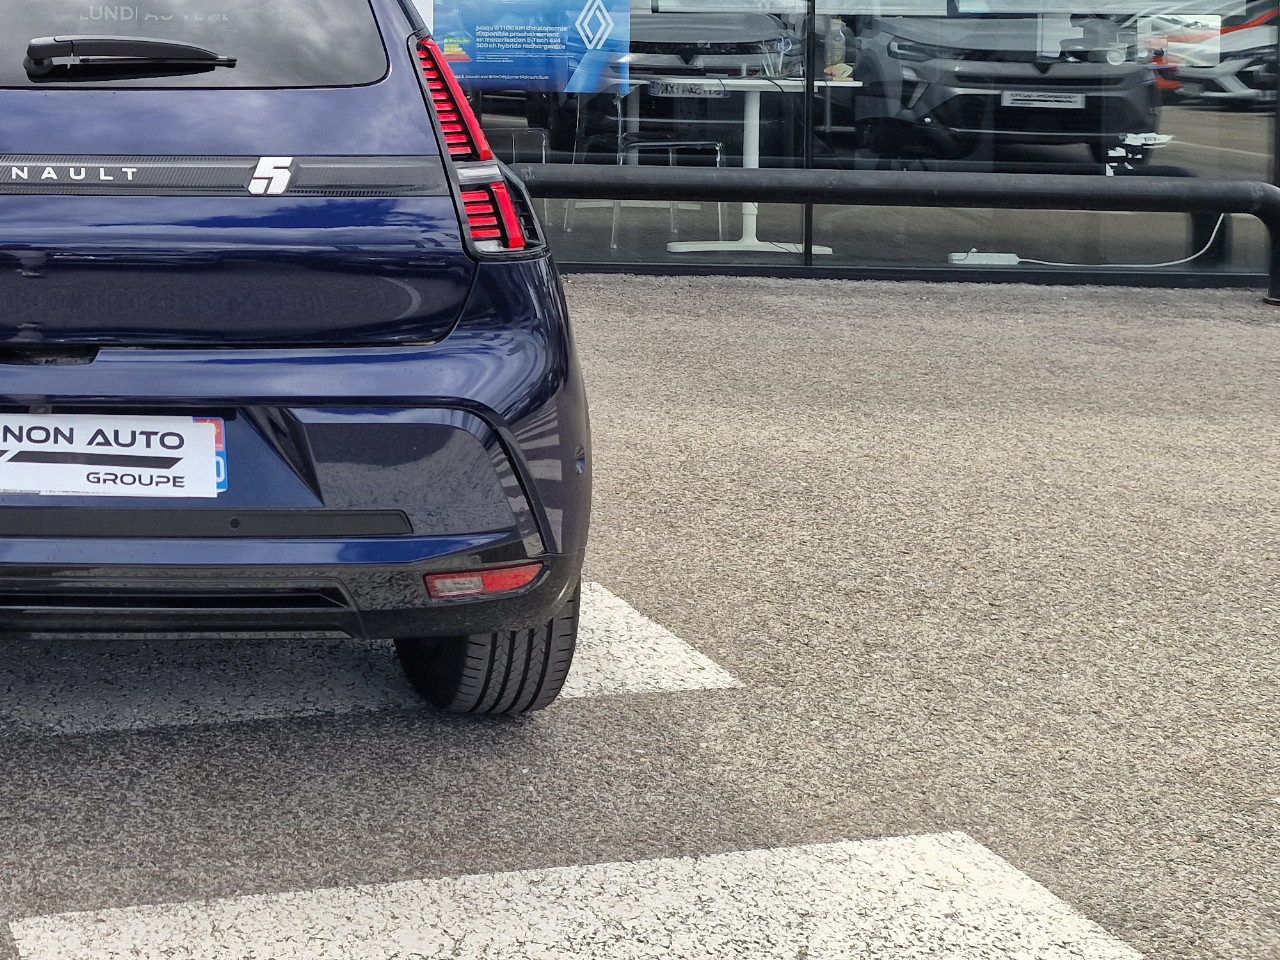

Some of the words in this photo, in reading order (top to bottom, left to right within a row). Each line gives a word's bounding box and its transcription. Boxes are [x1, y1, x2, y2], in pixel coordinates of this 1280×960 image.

[247, 156, 294, 195] 5
[85, 427, 185, 451] AUTO
[86, 471, 186, 489] GROUPE
